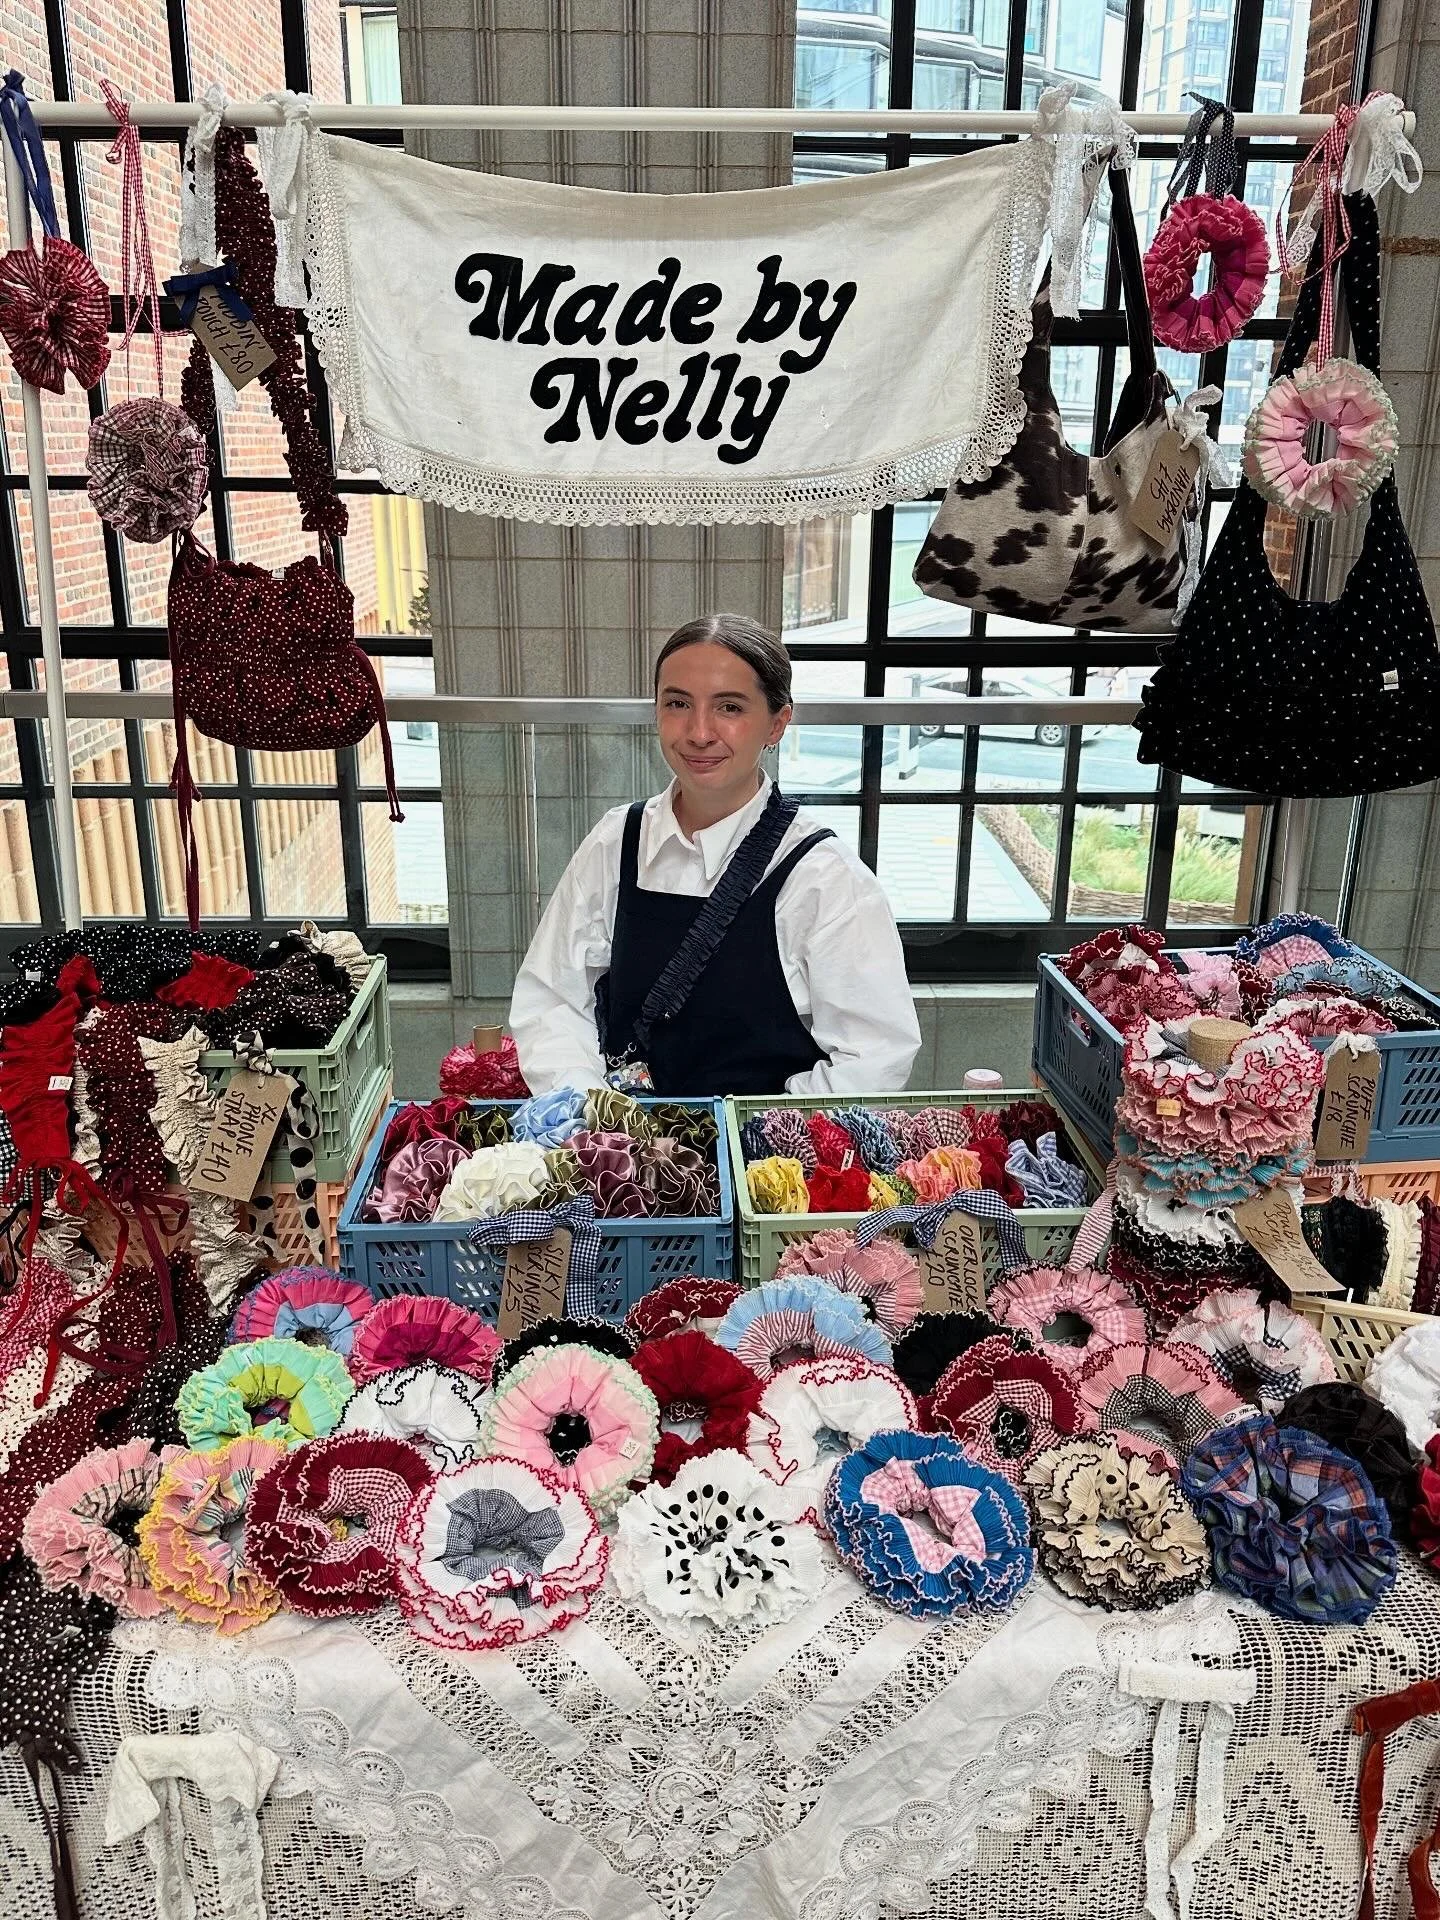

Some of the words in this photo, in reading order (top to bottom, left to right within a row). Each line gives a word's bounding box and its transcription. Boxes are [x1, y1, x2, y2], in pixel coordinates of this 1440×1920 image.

[196, 296, 231, 340] POUCH
[218, 342, 254, 374] £80
[454, 252, 723, 347] Made
[736, 254, 858, 374] by
[529, 351, 791, 465] Nelly
[1150, 461, 1173, 502] £45
[1156, 465, 1191, 534] HANDBAG
[217, 1090, 245, 1139] STRAP
[260, 1102, 278, 1125] XL
[1325, 1090, 1346, 1123] £18
[1340, 1072, 1361, 1150] SCRUNCHIE
[1359, 1076, 1376, 1121] PUFF
[235, 1101, 262, 1158] PHONE
[200, 1141, 233, 1183] £40
[505, 1263, 526, 1312] £25
[541, 1244, 565, 1301] SILKY
[925, 1248, 946, 1287] £20
[941, 1227, 963, 1308] SCRUNCHIE
[958, 1224, 979, 1310] OVERLOCK
